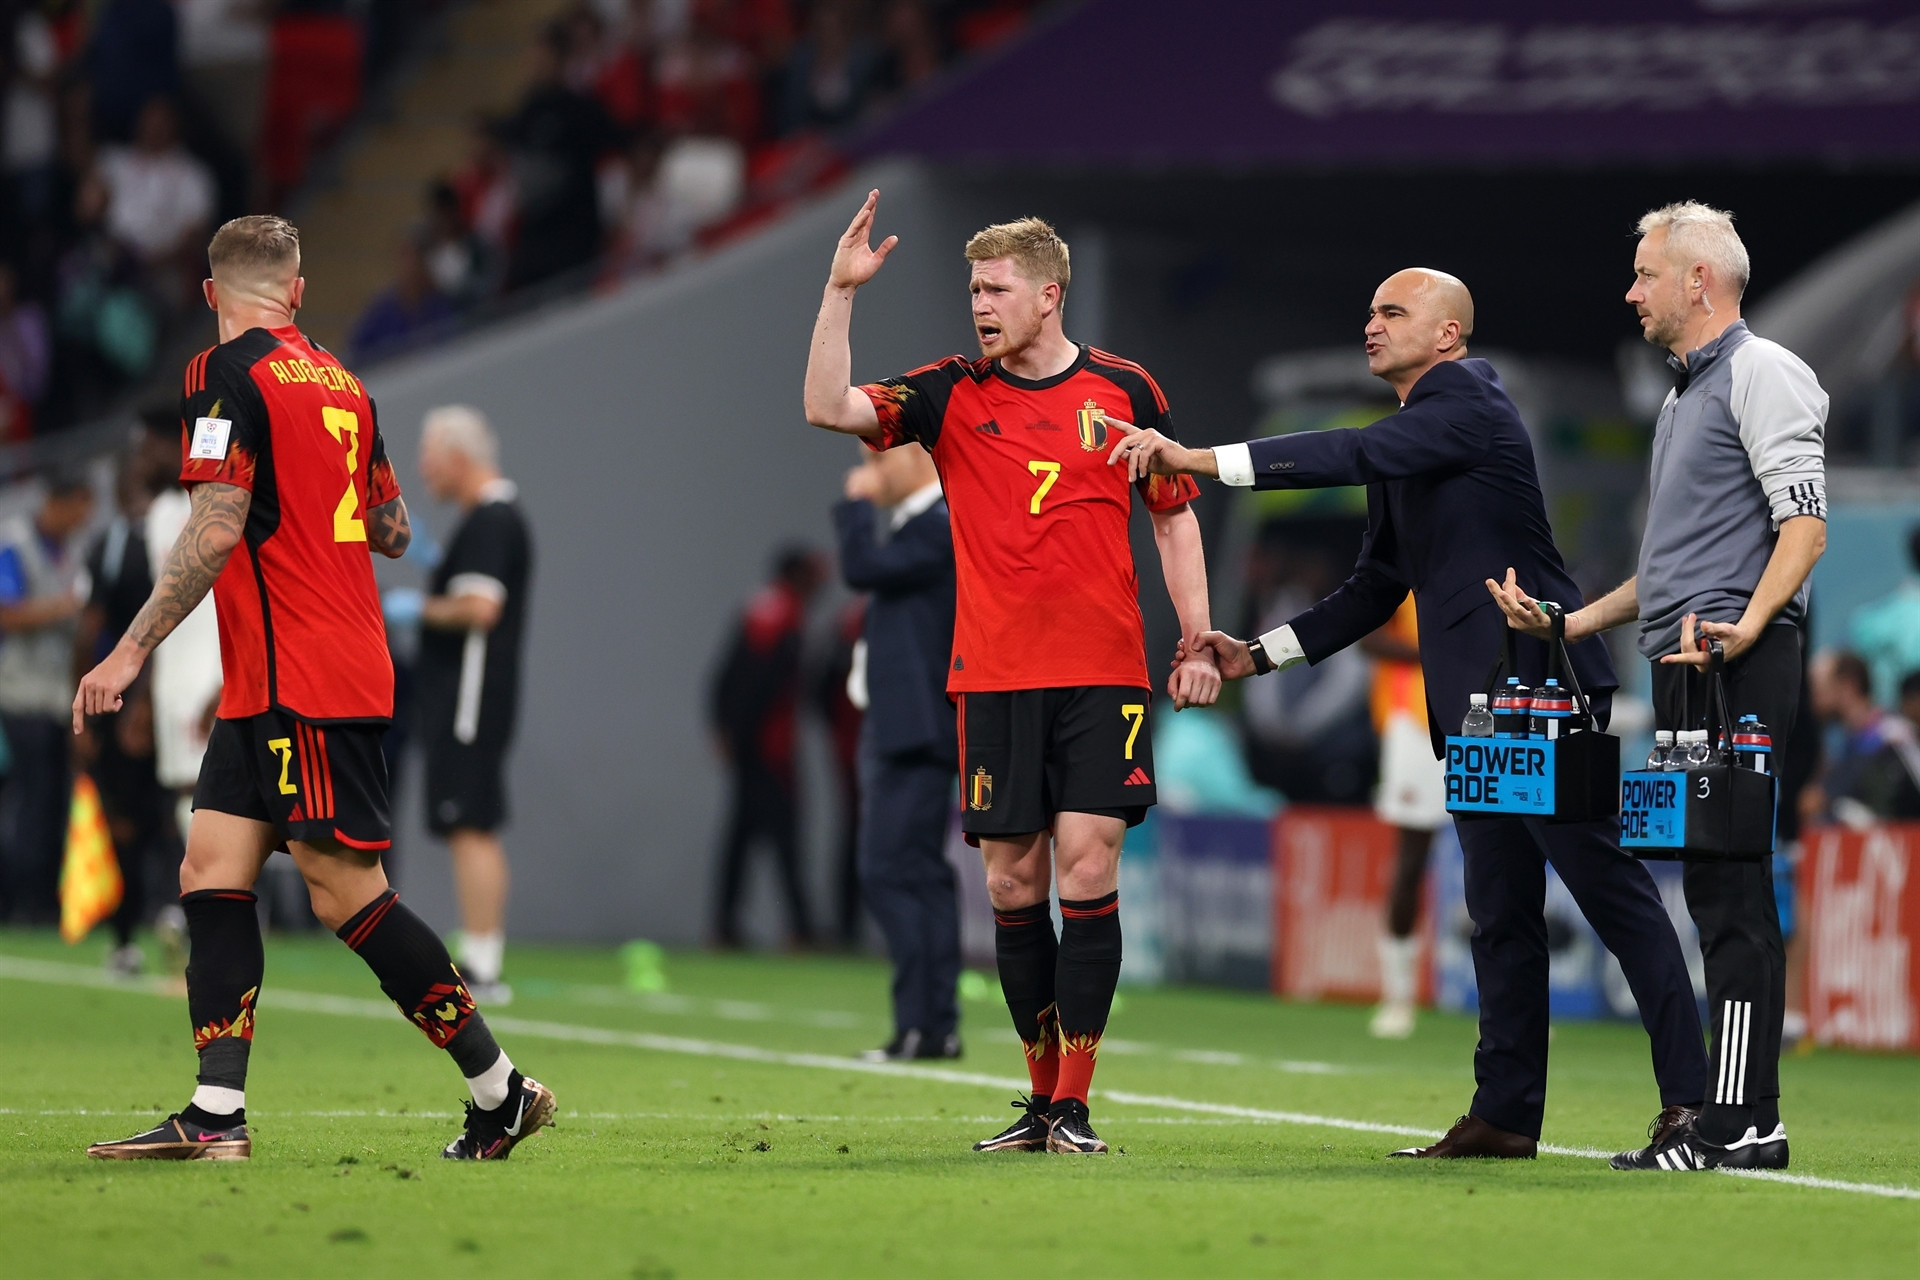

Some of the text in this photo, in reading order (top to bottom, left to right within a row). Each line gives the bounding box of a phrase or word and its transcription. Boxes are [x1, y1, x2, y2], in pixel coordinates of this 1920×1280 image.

[321, 405, 367, 543] 2
[1027, 460, 1061, 515] 7
[1121, 704, 1145, 760] 7
[267, 737, 298, 795] 2
[1447, 743, 1546, 777] POWER
[1446, 773, 1500, 805] ADE
[1621, 780, 1677, 809] POWER
[1696, 776, 1711, 799] 3
[1619, 810, 1649, 839] ADE
